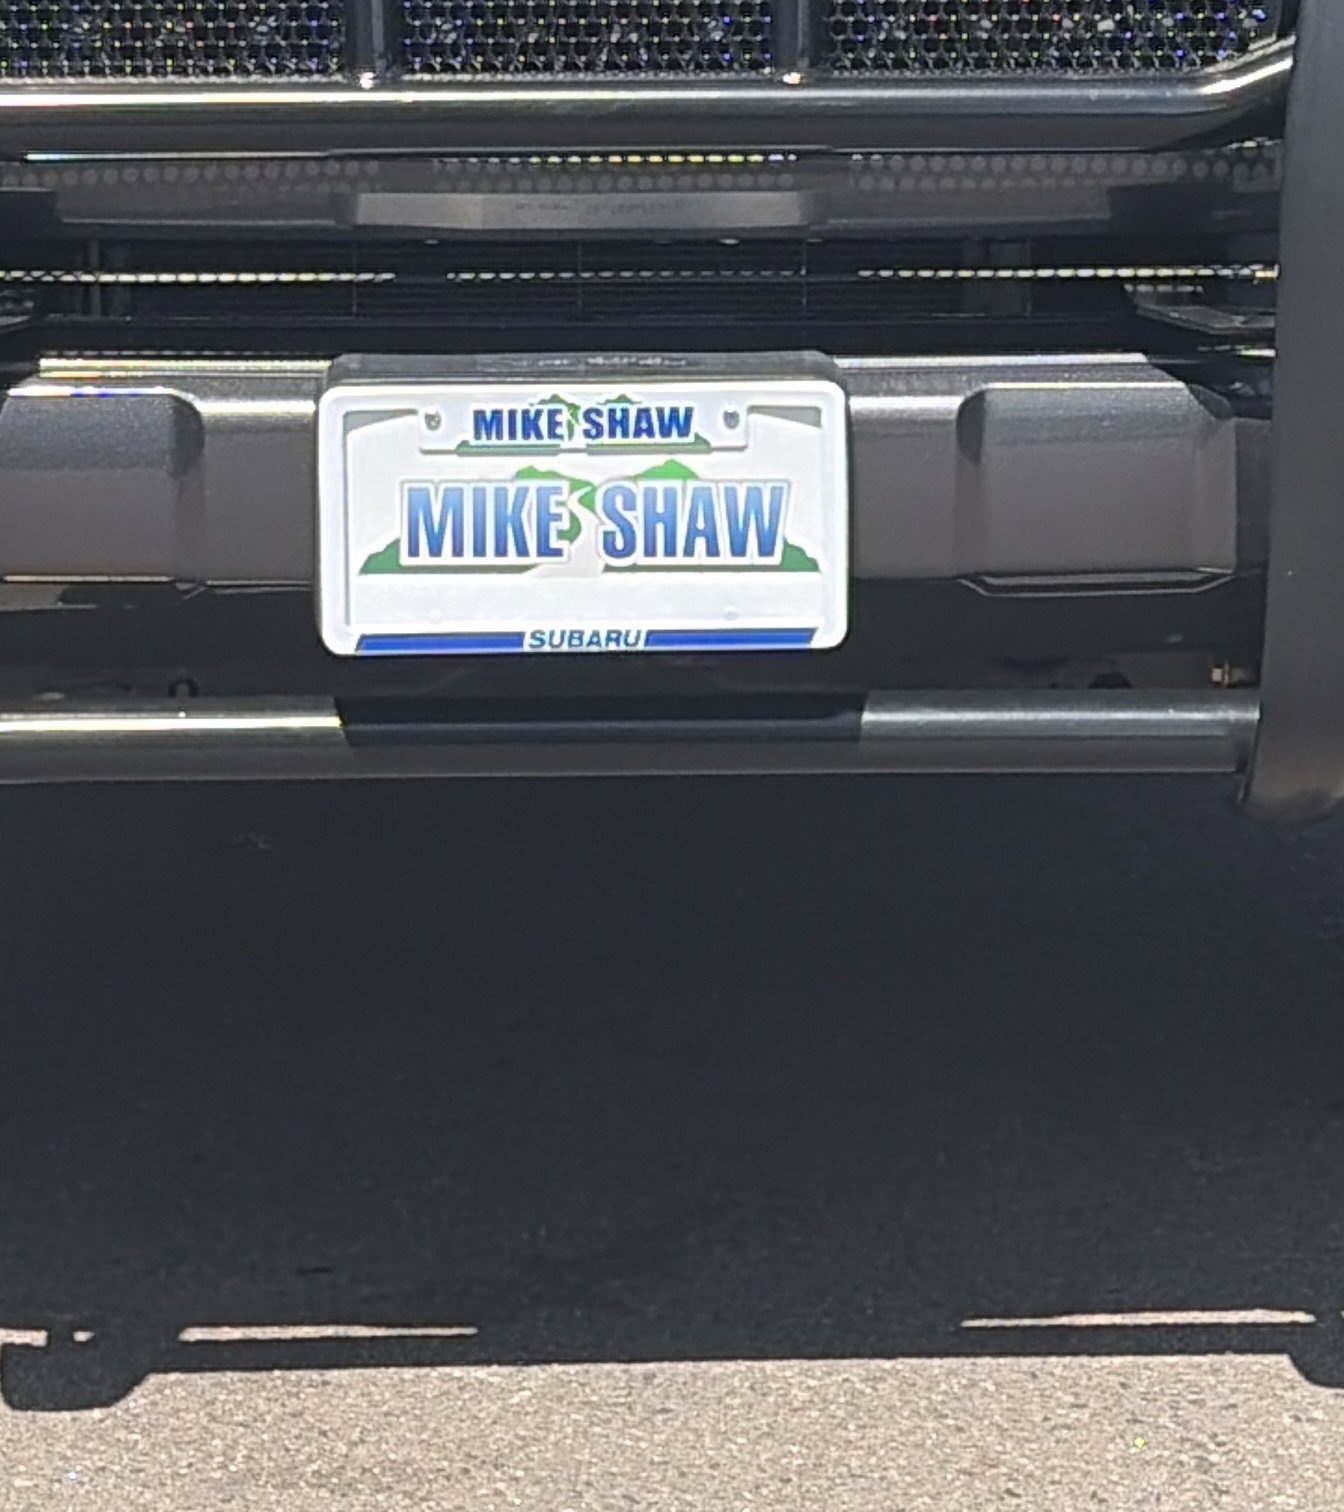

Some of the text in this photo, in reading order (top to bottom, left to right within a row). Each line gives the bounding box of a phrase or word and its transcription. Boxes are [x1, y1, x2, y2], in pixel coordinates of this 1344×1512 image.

[472, 405, 694, 441] MIKE SHAW
[406, 483, 786, 561] MIKE SHAW
[528, 629, 642, 650] SUBARU
